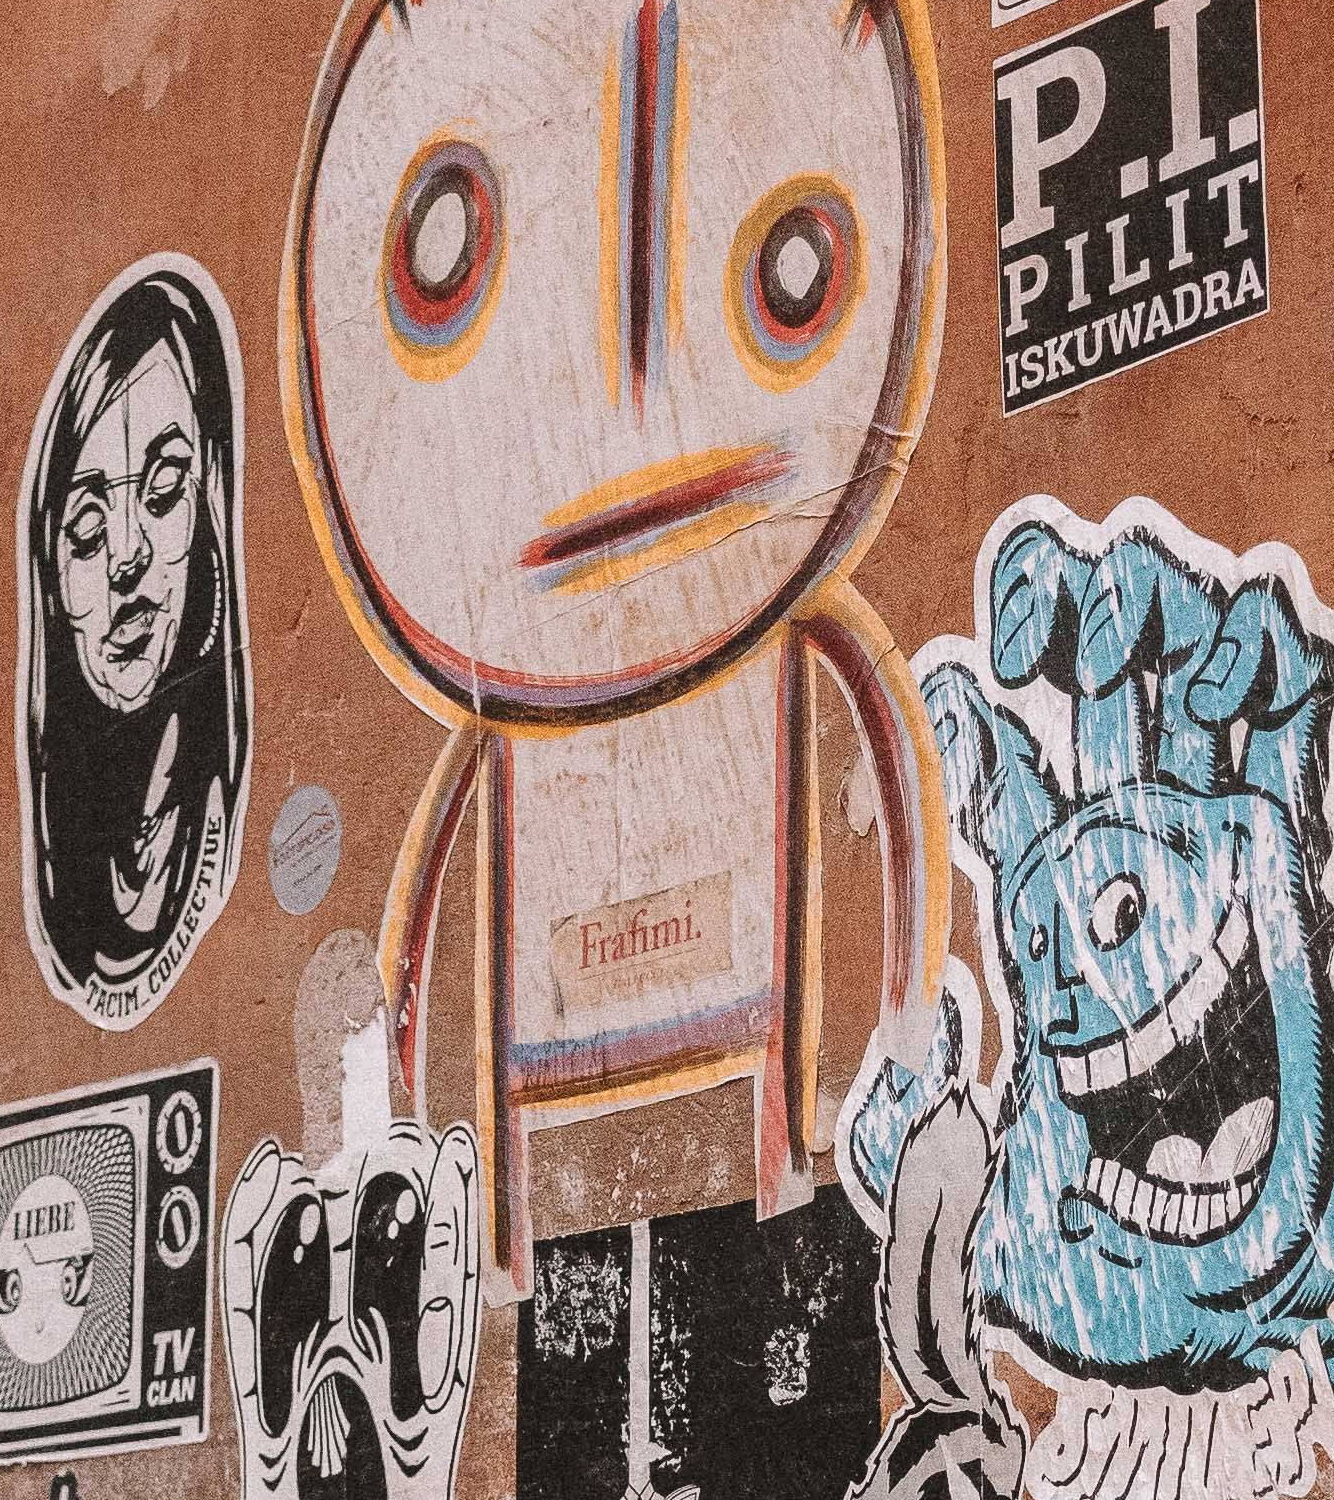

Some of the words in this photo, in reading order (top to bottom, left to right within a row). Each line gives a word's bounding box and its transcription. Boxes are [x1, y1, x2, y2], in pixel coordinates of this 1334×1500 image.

[1004, 159, 1259, 337] PILIT
[1005, 258, 1265, 397] ISKUWADRA
[146, 1375, 196, 1407] CLAN
[153, 1327, 195, 1376] TV
